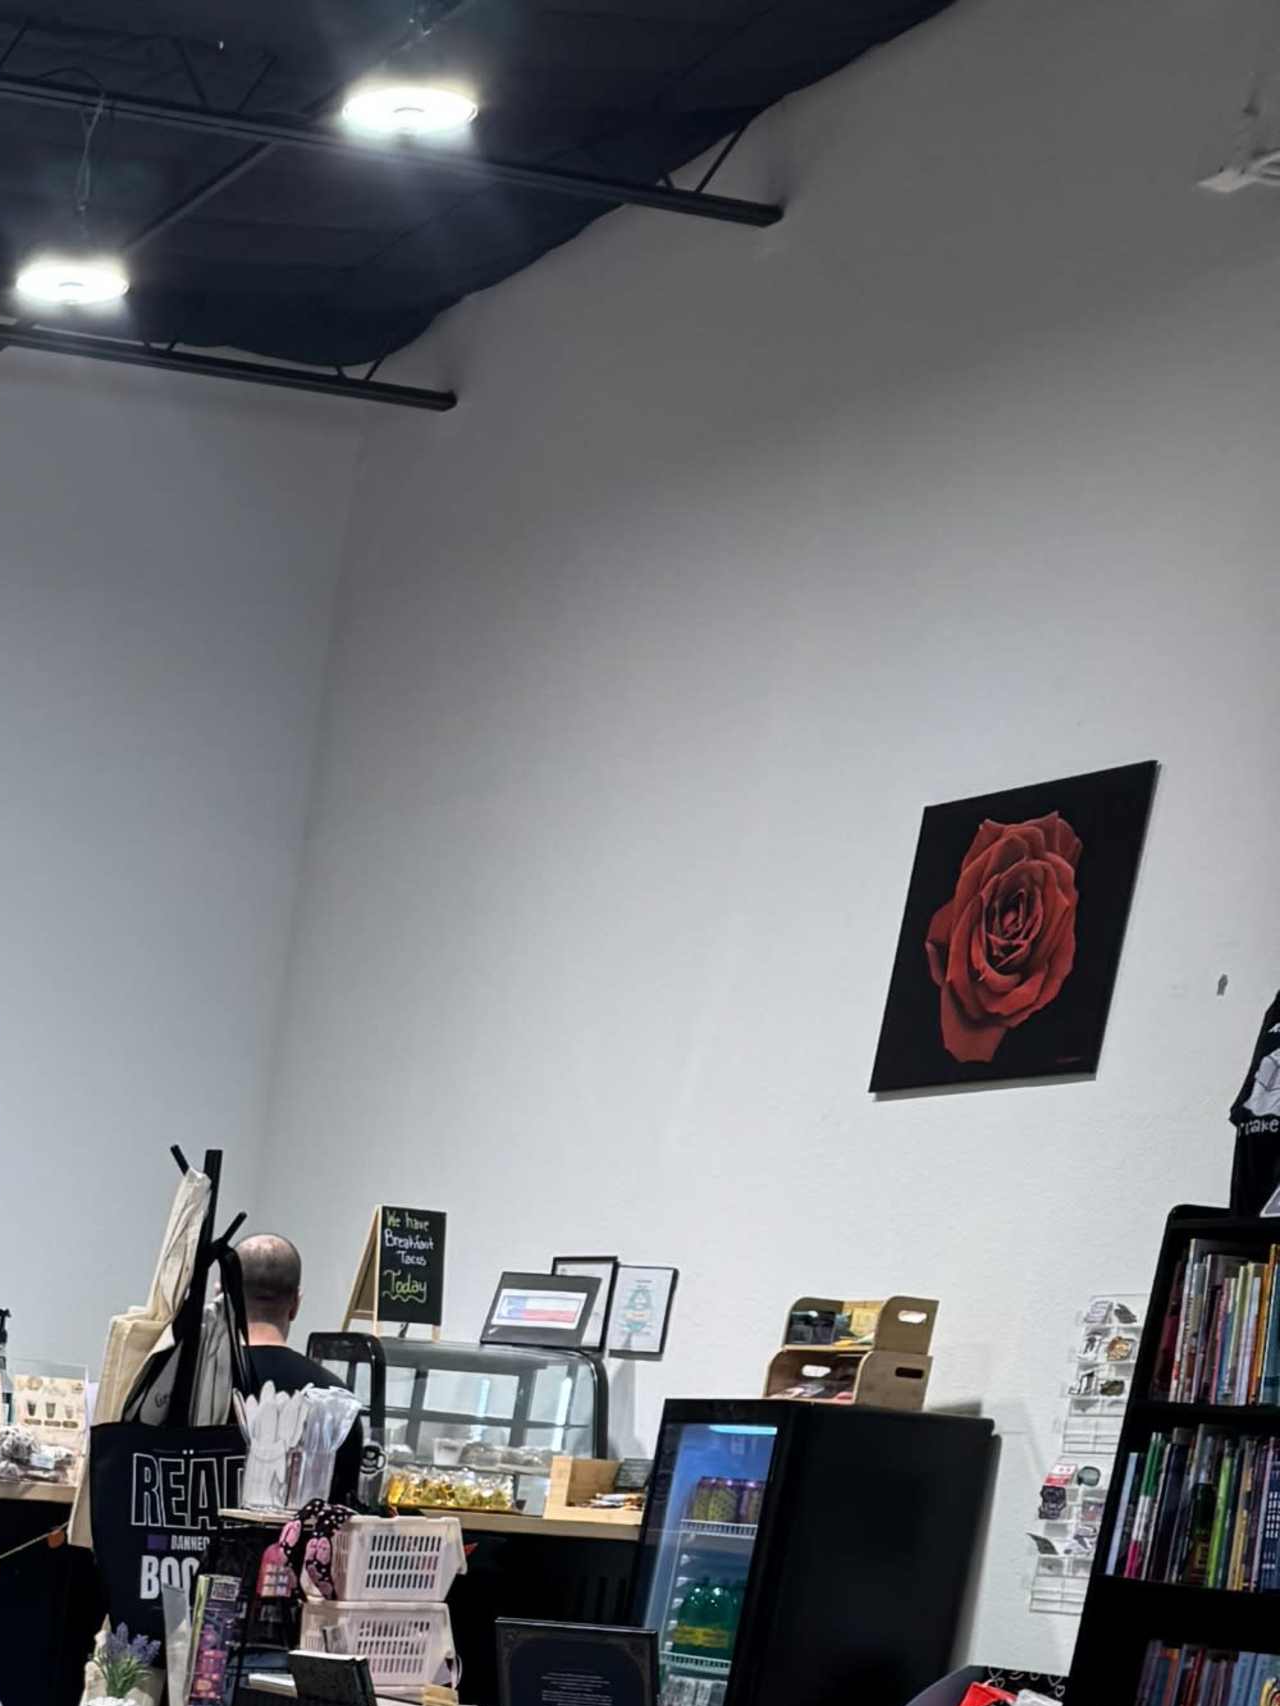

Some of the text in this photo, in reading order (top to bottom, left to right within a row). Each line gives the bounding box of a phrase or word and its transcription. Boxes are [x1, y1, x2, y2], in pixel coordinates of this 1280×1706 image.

[386, 1208, 429, 1232] We have
[396, 1250, 427, 1266] Tacos
[383, 1269, 428, 1300] Today
